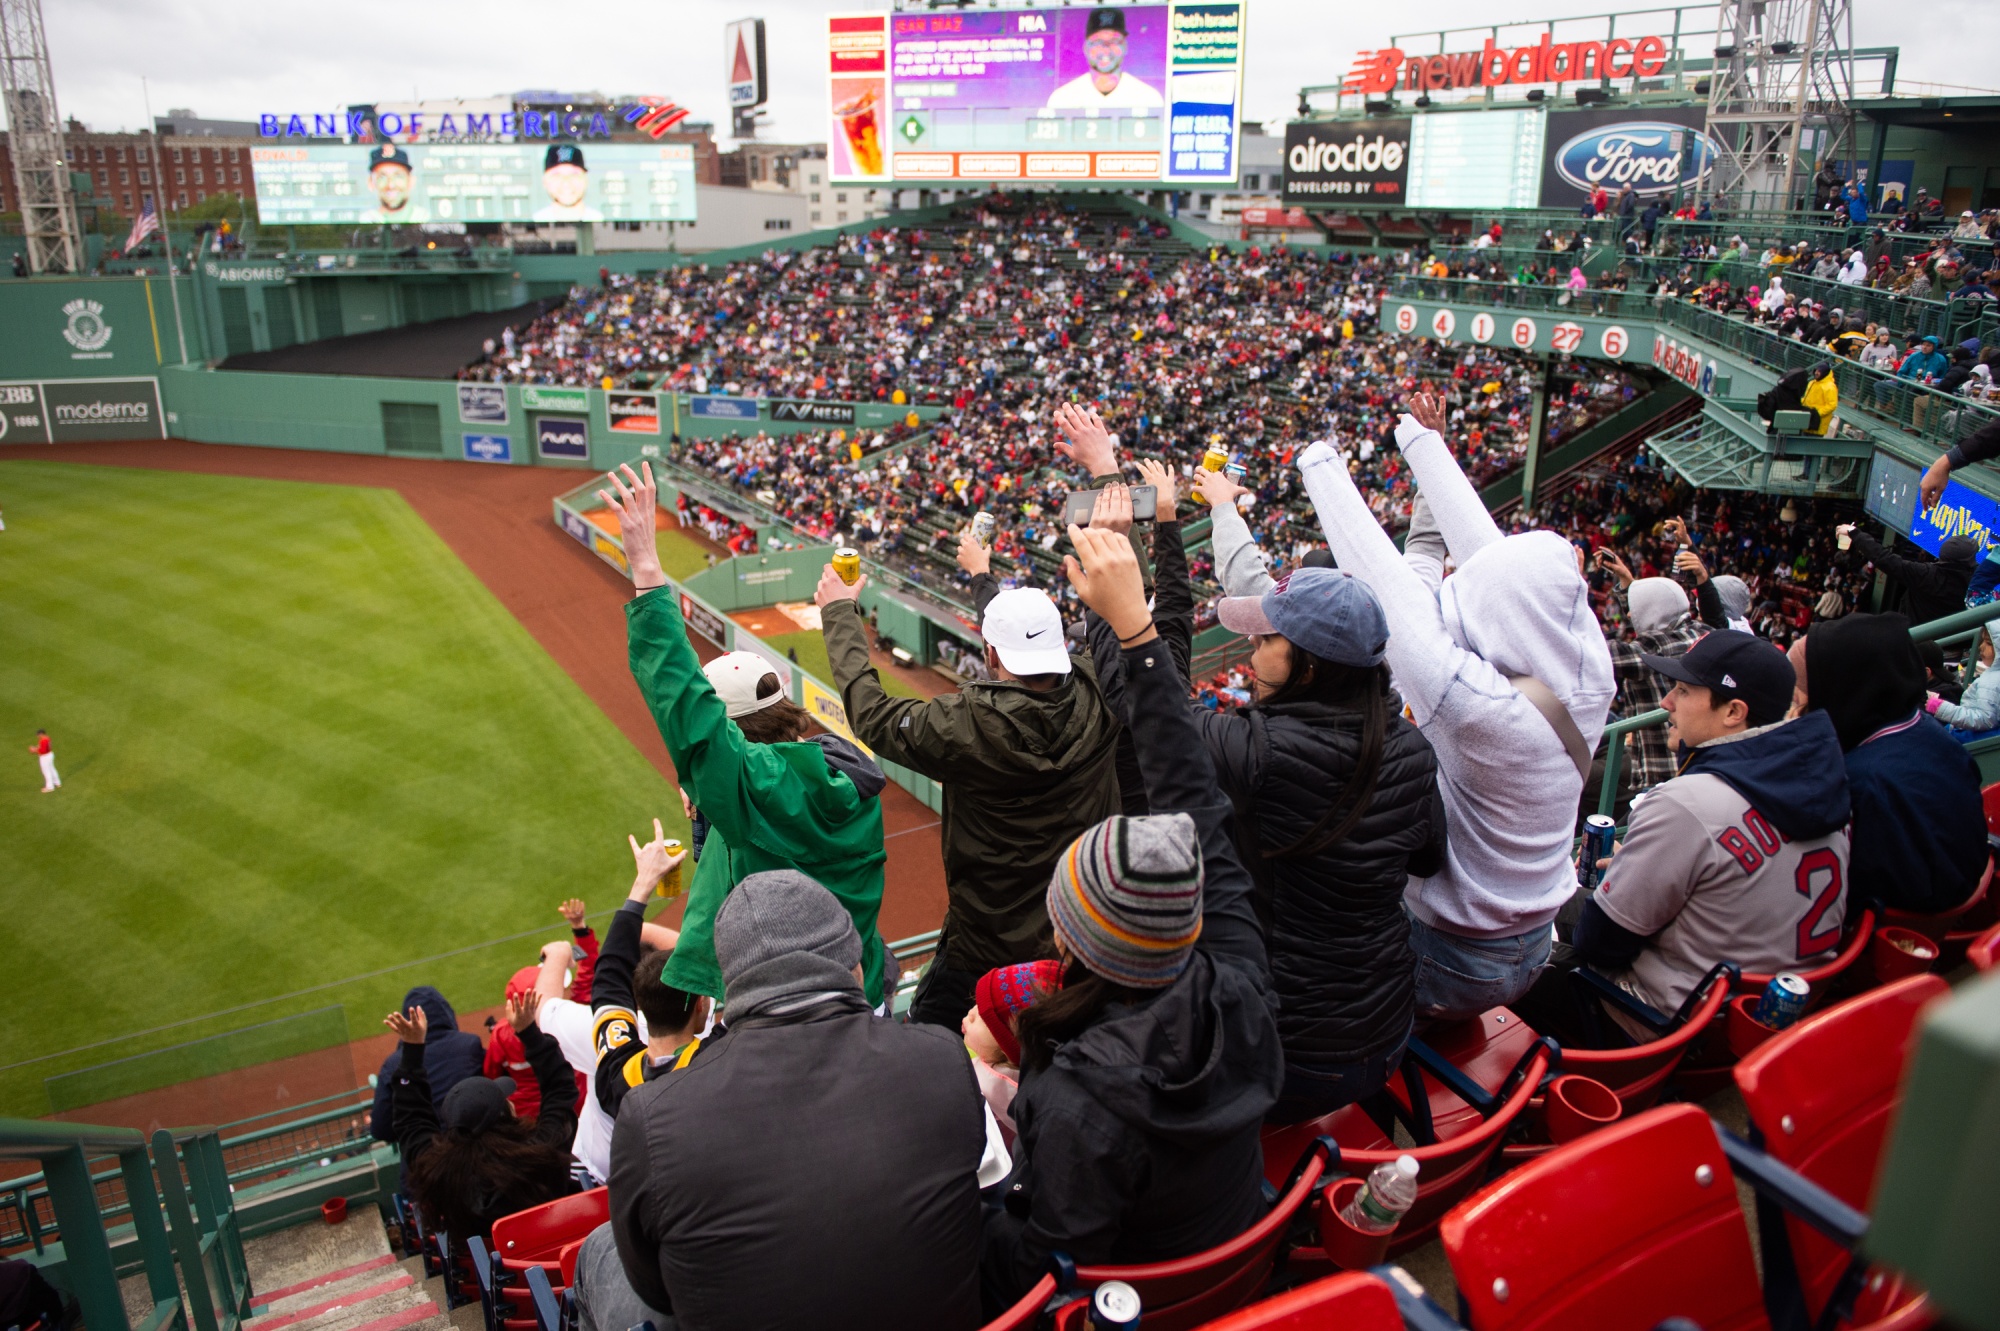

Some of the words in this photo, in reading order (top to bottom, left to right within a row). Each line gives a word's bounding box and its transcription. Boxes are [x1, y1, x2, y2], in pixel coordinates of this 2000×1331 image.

[1018, 15, 1047, 33] MIA
[1174, 13, 1204, 29] Beth
[1205, 12, 1238, 28] Israel
[1403, 51, 1483, 91] new
[1481, 33, 1667, 87] balance
[260, 112, 366, 138] BANK
[378, 112, 425, 137] OF
[438, 110, 611, 137] AMERICA
[1086, 122, 1097, 139] 2
[1289, 134, 1404, 173] airocide
[1585, 133, 1682, 183] Ford
[266, 184, 283, 196] 76
[1288, 181, 1352, 194] DEVELOPED
[1355, 181, 1371, 194] BY
[438, 198, 453, 218] 0
[219, 267, 285, 281] ABIOMED
[1399, 310, 1412, 330] 9
[1435, 316, 1447, 334] 4
[1515, 323, 1529, 344] 8
[1552, 327, 1583, 350] 27
[1605, 332, 1621, 354] 6
[55, 401, 148, 419] moderna
[813, 407, 853, 421] NESN
[815, 696, 845, 725] TWISTED
[1795, 846, 1842, 961] 2
